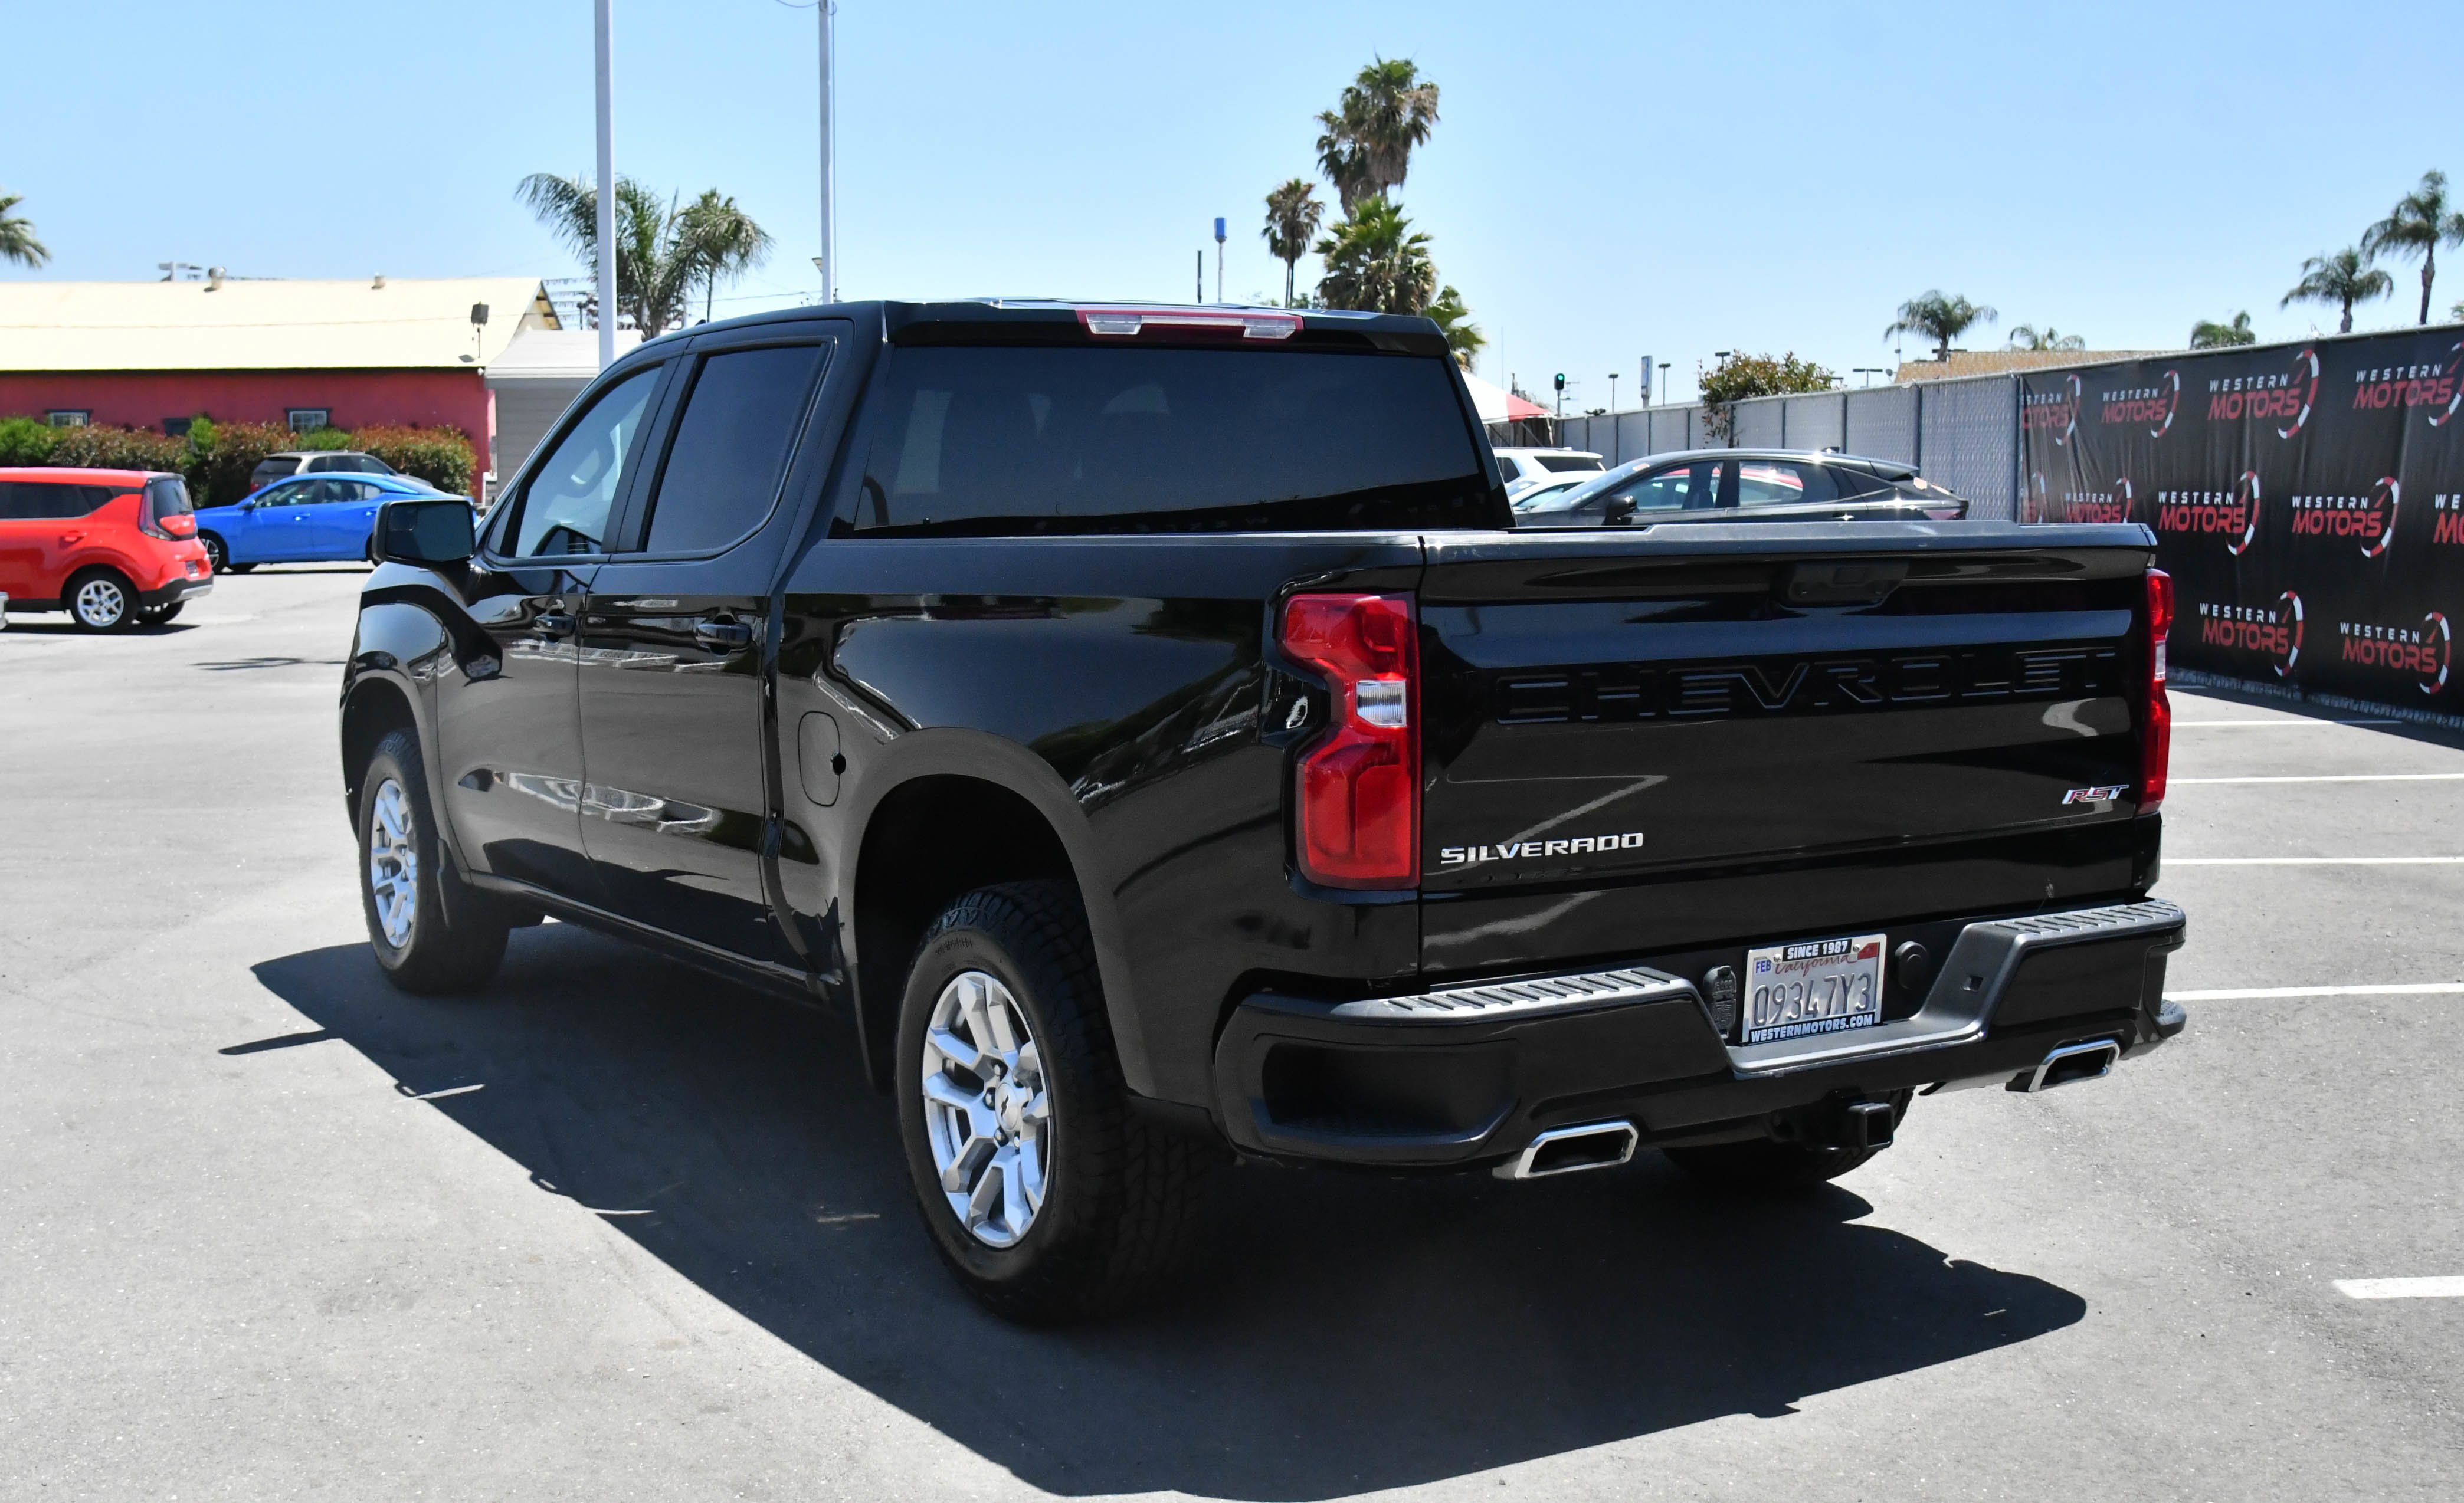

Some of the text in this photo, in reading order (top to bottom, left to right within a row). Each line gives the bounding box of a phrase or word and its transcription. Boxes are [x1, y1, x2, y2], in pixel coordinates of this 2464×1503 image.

[2209, 373, 2288, 392] WESTERN
[2355, 363, 2442, 383] WESTERN
[2103, 388, 2158, 402] WESTERN
[2208, 388, 2301, 421] MOTORS
[2353, 378, 2454, 410] MOTORS
[2101, 399, 2167, 423] MOTORS
[2158, 491, 2233, 505] WESTERN
[2292, 495, 2368, 509] WESTERN
[2158, 506, 2244, 533] MOTORS
[2292, 510, 2383, 536] MOTORS
[2200, 602, 2276, 623] WESTERN
[2202, 618, 2289, 654] MOTORS
[2340, 622, 2419, 644] WESTERN
[2342, 637, 2437, 673] MOTORS
[1496, 647, 2115, 724] CHEVROLET
[2062, 785, 2129, 805] RST
[1441, 832, 1643, 864] SILVERADO
[1787, 944, 1818, 959] SINCE
[1822, 941, 1847, 954] 1987
[1755, 960, 1771, 973] FEB
[1754, 973, 1871, 1026] 09347Y3
[1751, 1014, 1873, 1042] WESTERNMOTORS.COM
